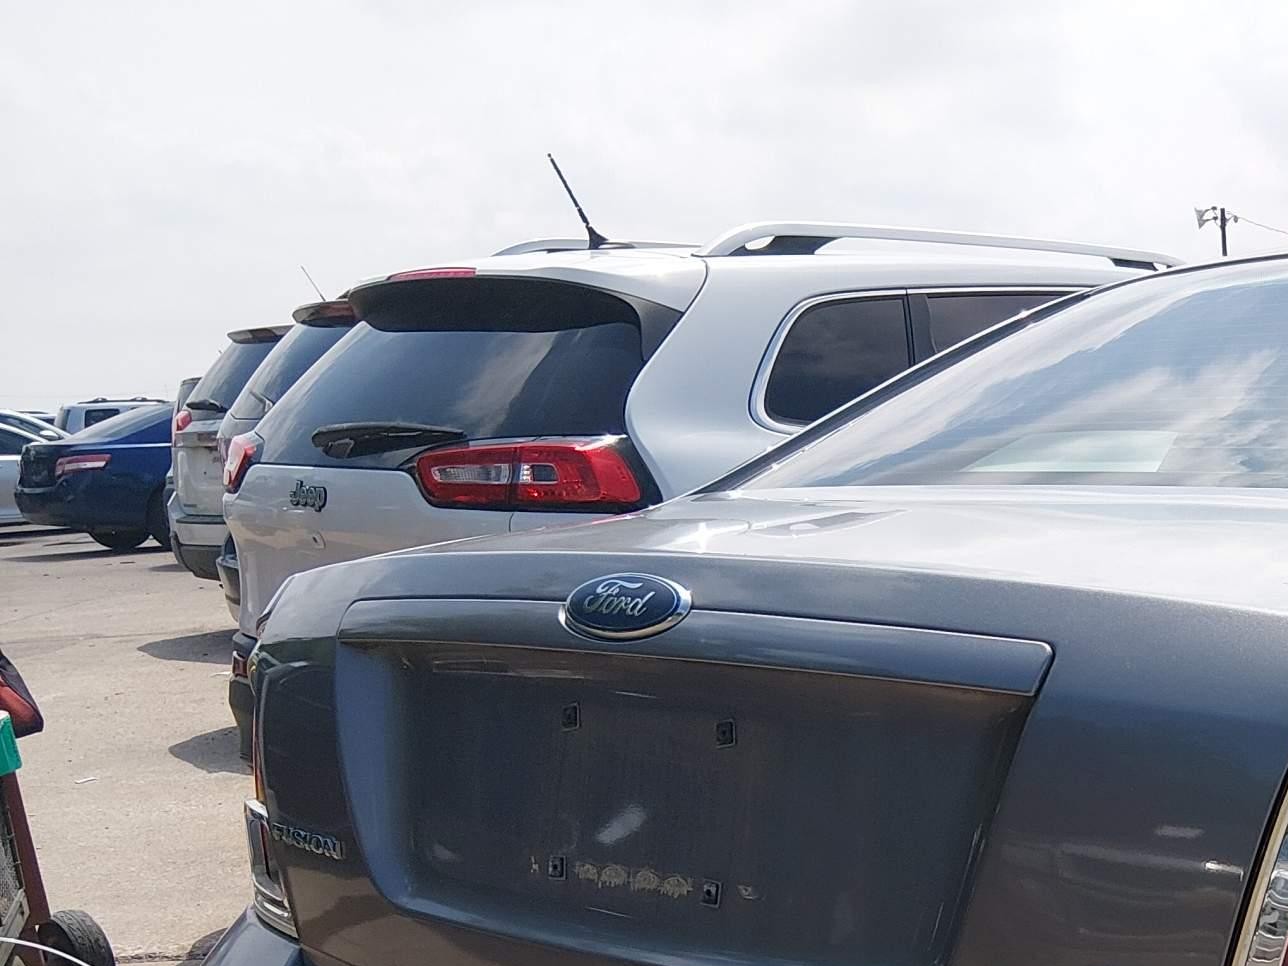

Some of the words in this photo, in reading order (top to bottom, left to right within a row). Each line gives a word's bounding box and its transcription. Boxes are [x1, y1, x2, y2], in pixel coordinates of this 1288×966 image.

[289, 479, 328, 512] Jeep
[583, 579, 656, 617] Ford
[272, 822, 346, 861] FUSION
